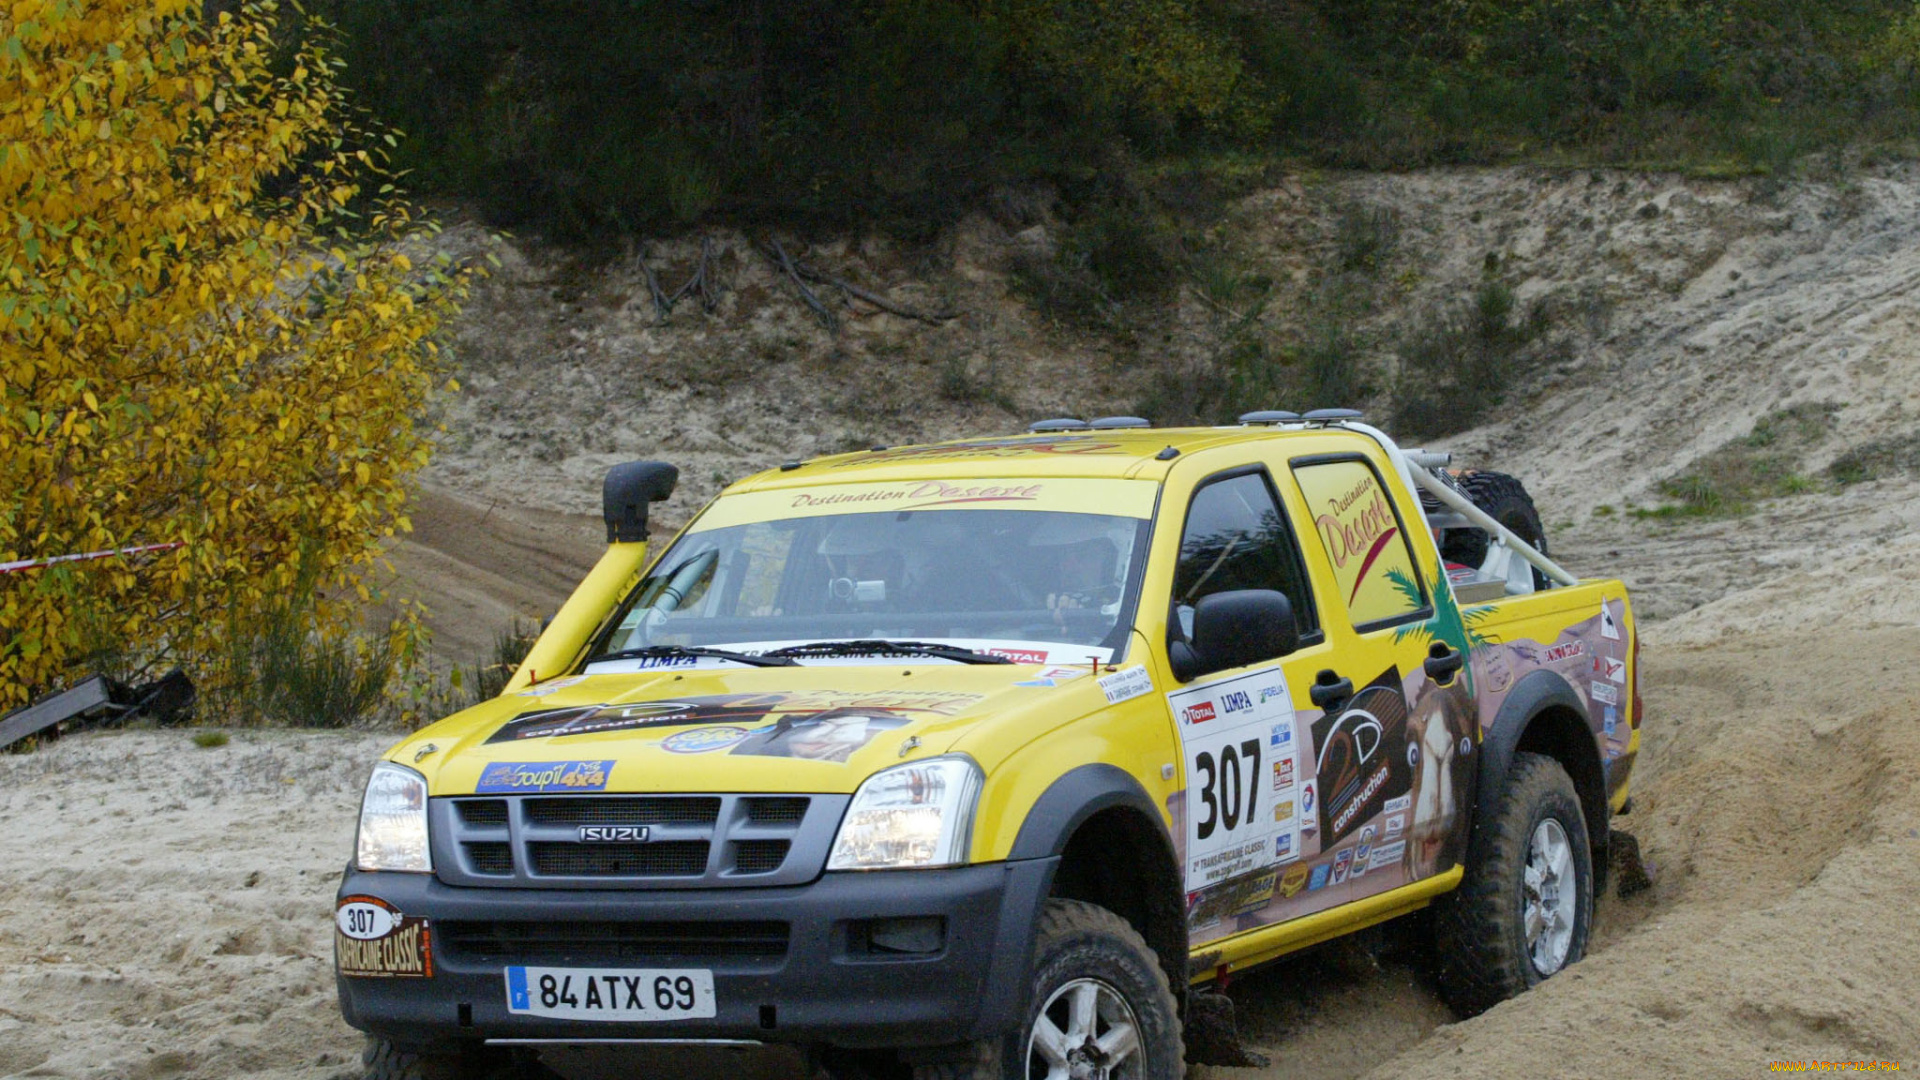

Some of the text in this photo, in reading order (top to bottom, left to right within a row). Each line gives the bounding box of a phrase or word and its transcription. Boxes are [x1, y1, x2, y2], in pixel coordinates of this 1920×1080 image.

[791, 490, 905, 508] Destination
[1328, 476, 1373, 517] Destination
[1317, 489, 1392, 569] Desert
[638, 655, 698, 669] LIMPA
[1190, 708, 1215, 719] TOTAL
[1220, 690, 1252, 713] LIMPA
[1195, 738, 1261, 840] 307
[1333, 766, 1388, 833] construction
[580, 828, 648, 841] ISUZU
[348, 908, 375, 933] 307
[383, 923, 422, 972] CLASSIC
[539, 974, 696, 1011] 84 ATX 69
